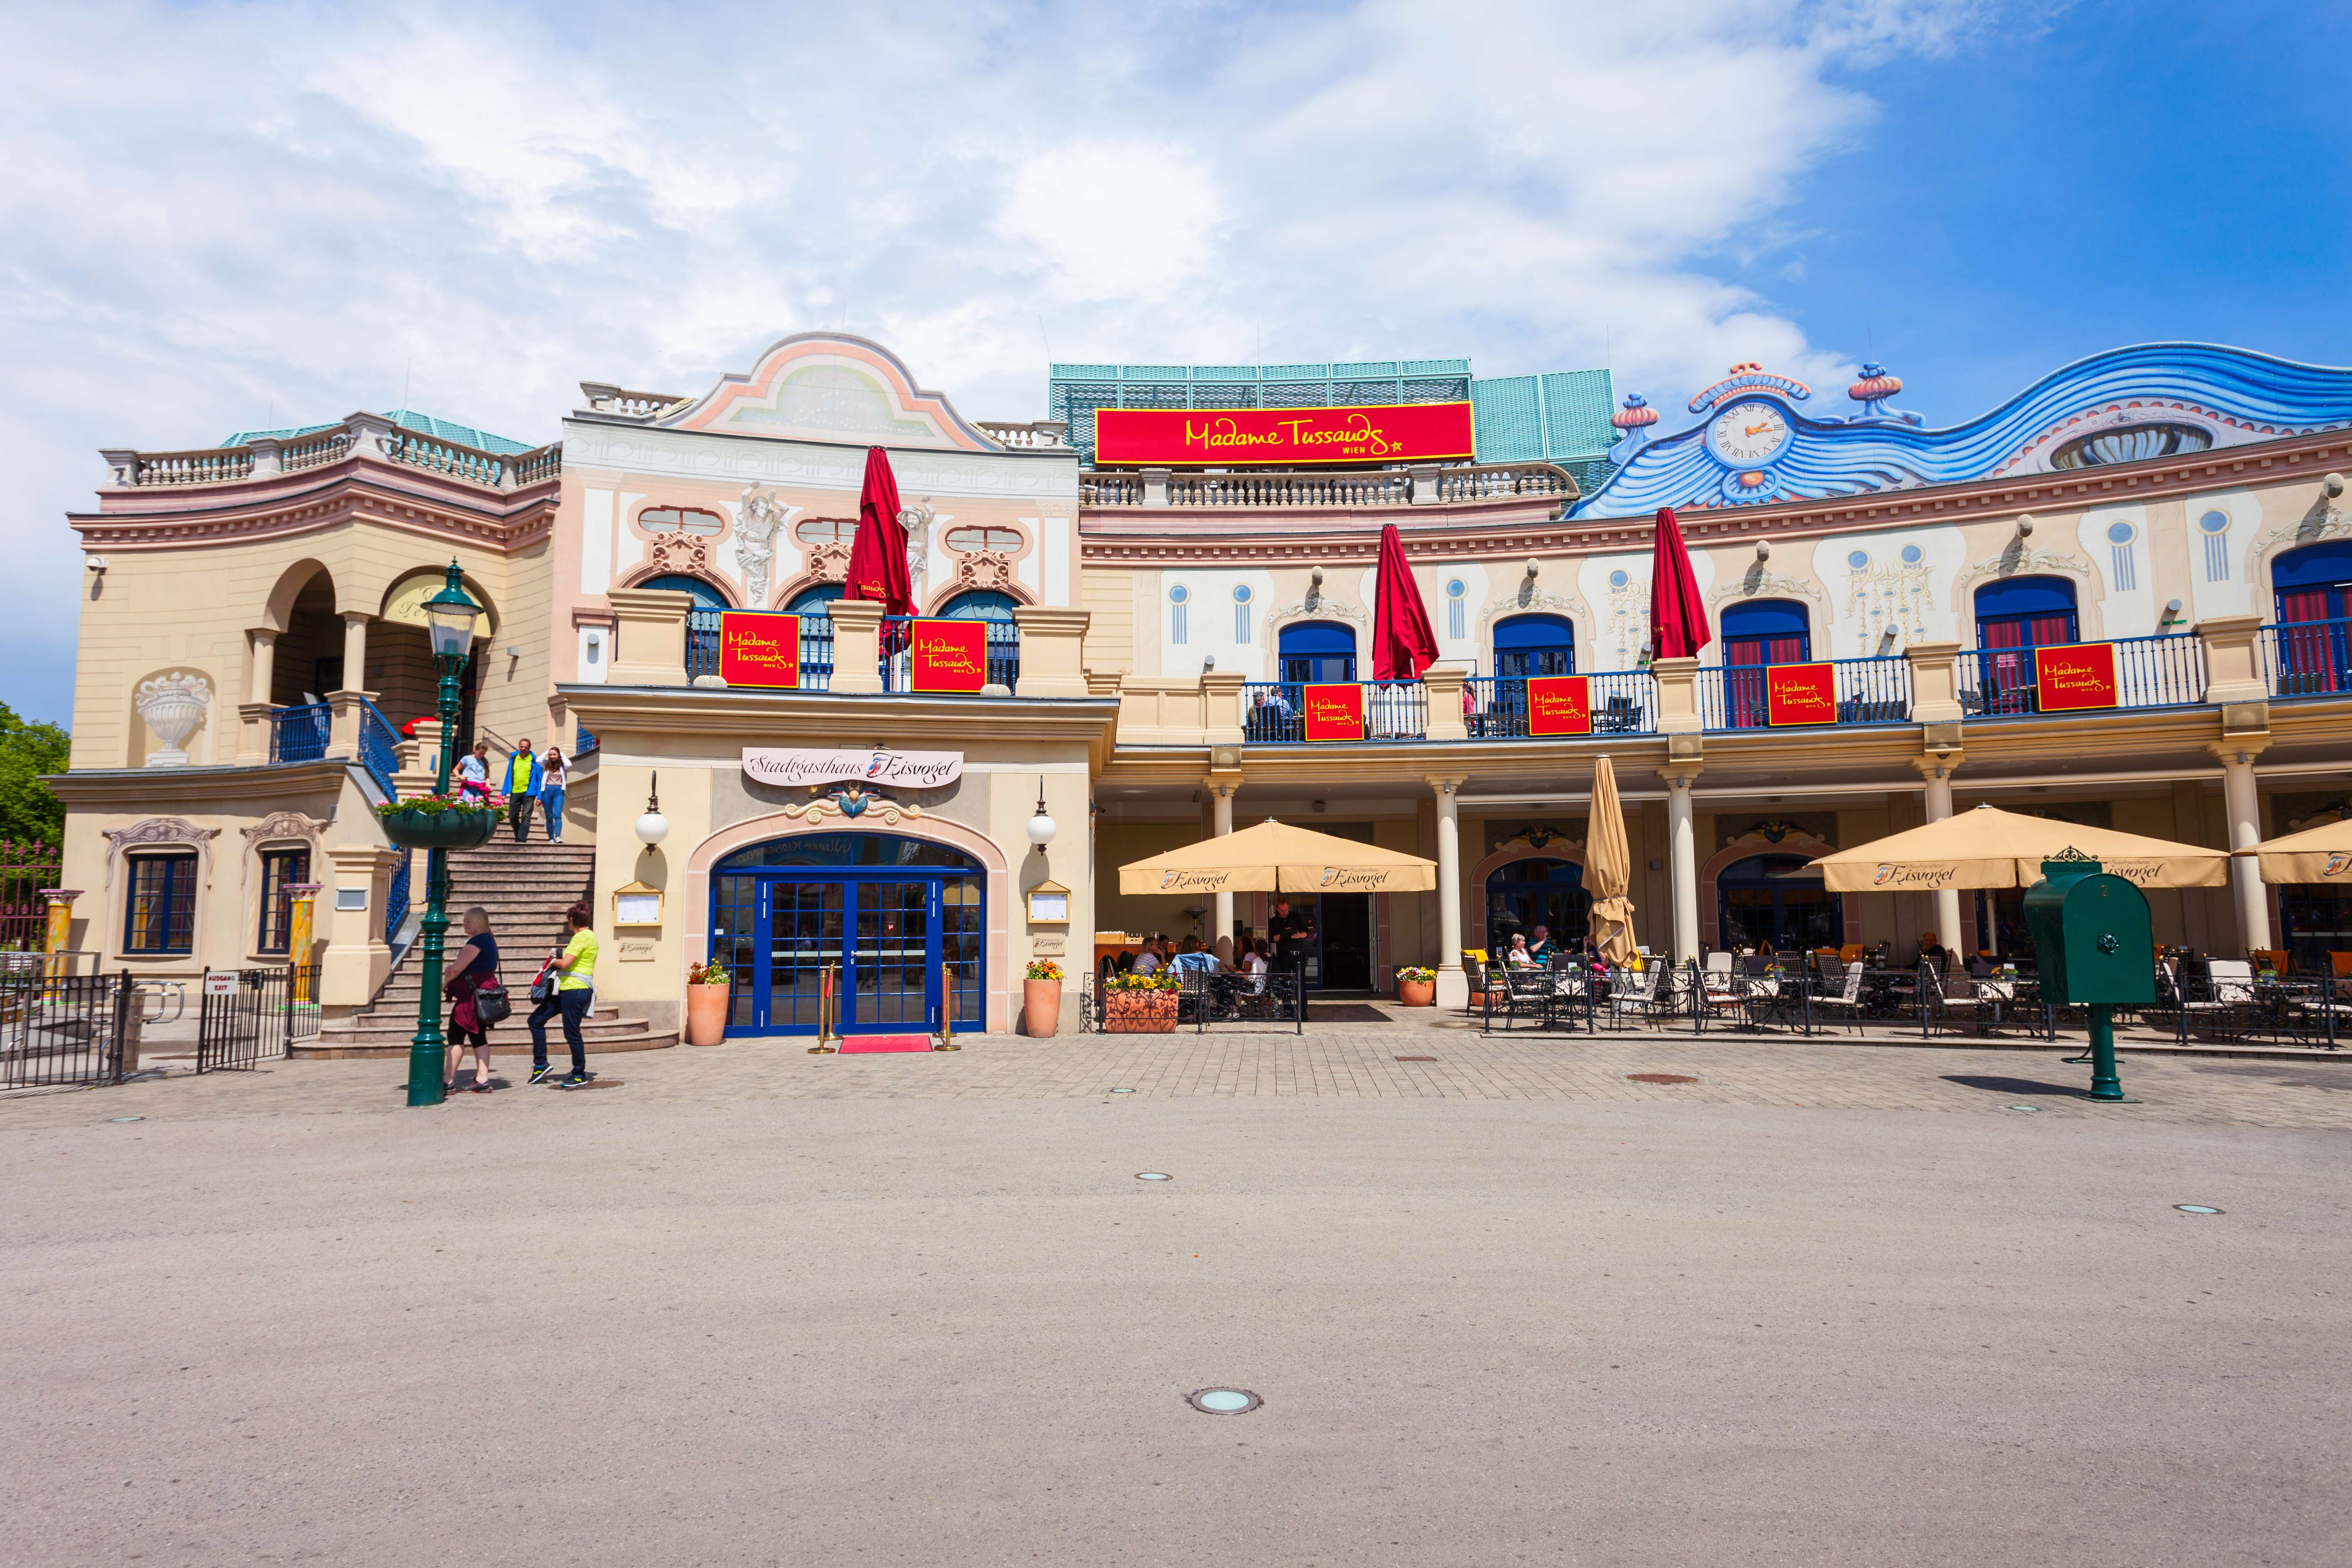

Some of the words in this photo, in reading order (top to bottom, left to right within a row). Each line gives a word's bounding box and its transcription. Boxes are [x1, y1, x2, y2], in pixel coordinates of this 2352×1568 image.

[1186, 418, 1284, 449] Madame
[1278, 414, 1388, 455] Tussauds
[729, 631, 780, 647] Madame
[920, 638, 968, 653] Madame
[730, 647, 787, 669] Tussauds
[921, 653, 975, 674] Tussauds
[2045, 662, 2095, 676] Madame
[1774, 680, 1818, 694] Madame
[2047, 673, 2104, 691] Tussauds
[1310, 698, 1348, 711] Madame
[1534, 691, 1574, 704] Madame
[1776, 691, 1825, 708] Tussauds
[1312, 709, 1354, 726] Tussauds
[1536, 703, 1581, 719] Tussauds
[750, 754, 864, 782] Stadtgasthaus
[866, 753, 958, 784] Eisvogel
[1161, 869, 1232, 891] Eisvogel
[1320, 867, 1391, 890] Eisvogel
[1874, 863, 1960, 888] Eisvogel
[2102, 861, 2166, 885] isvogel
[2100, 885, 2108, 897] 2
